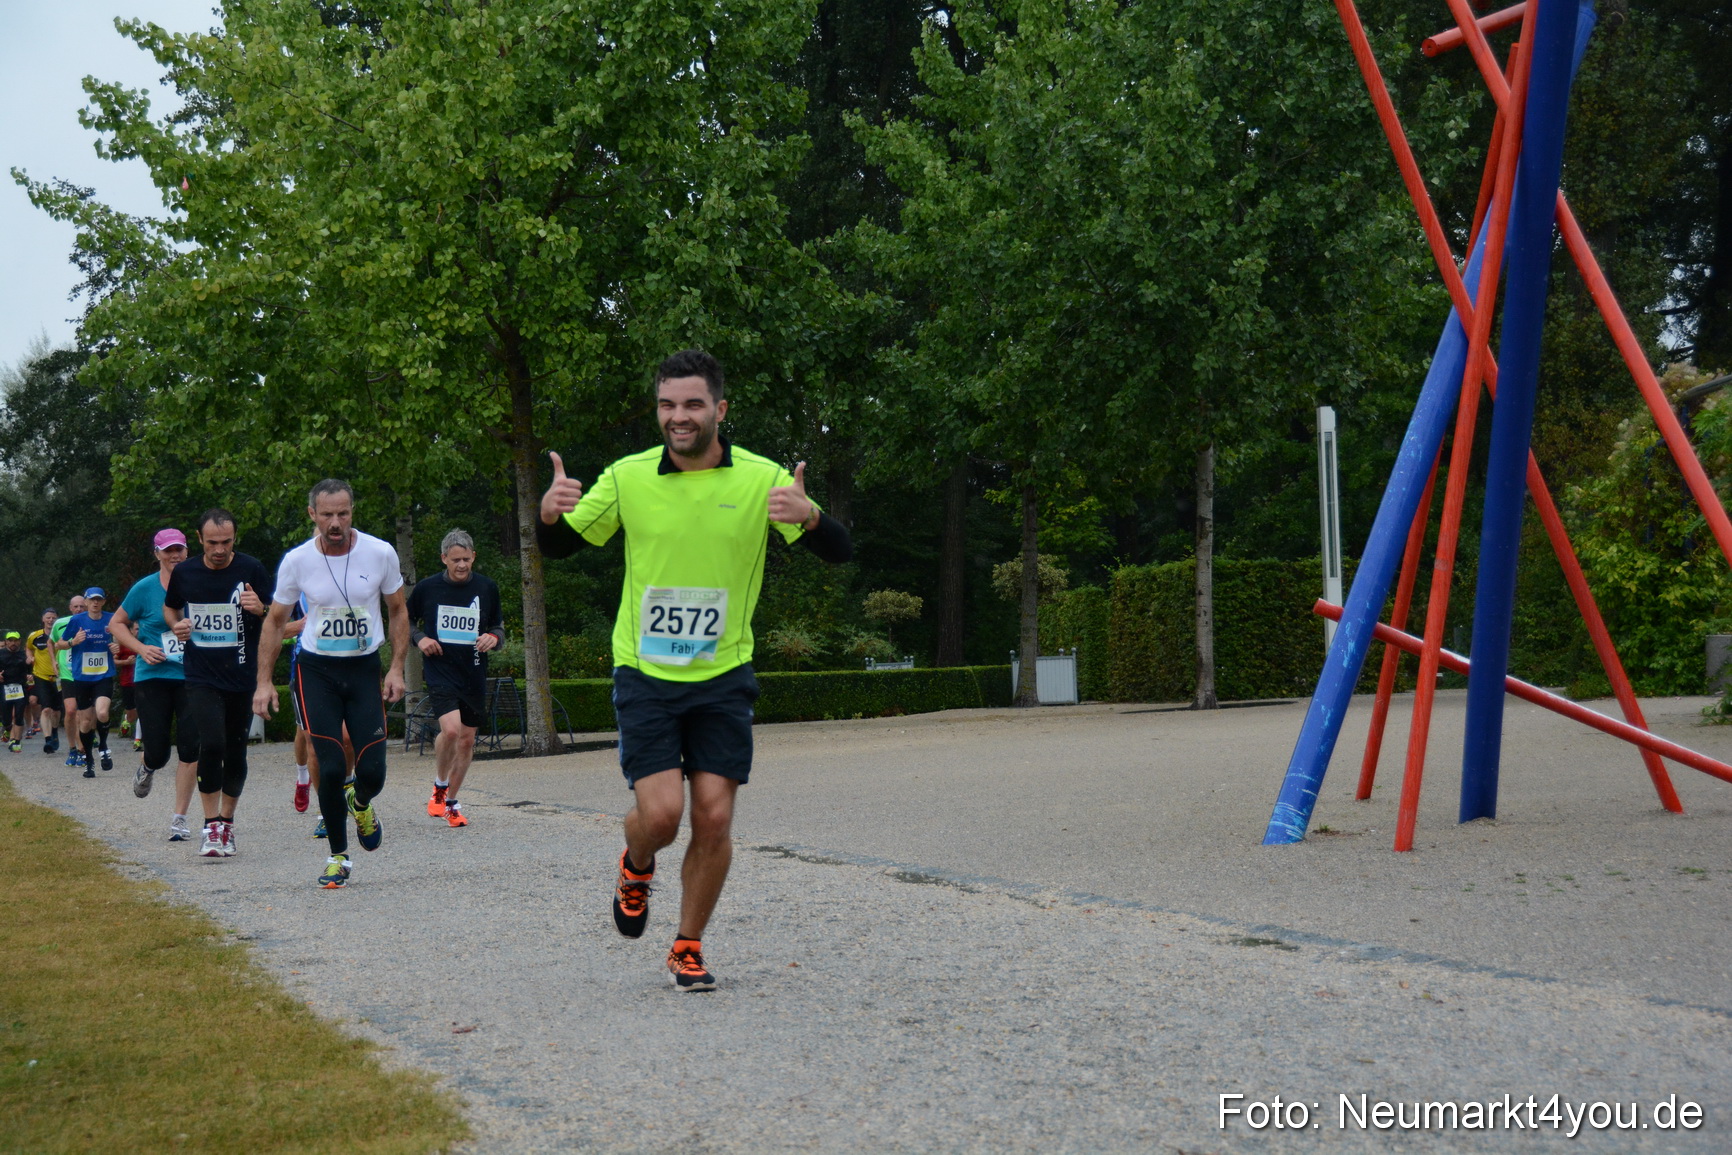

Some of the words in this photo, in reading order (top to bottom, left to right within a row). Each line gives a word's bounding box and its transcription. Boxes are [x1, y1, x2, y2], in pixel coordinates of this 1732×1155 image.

[680, 591, 720, 600] BOCK
[194, 614, 233, 631] 2458
[321, 618, 368, 637] 2005
[441, 615, 475, 631] 3009
[649, 605, 719, 636] 2572
[237, 606, 246, 664] RAIL.ONE
[671, 642, 695, 654] Fabi
[88, 657, 104, 667] 600
